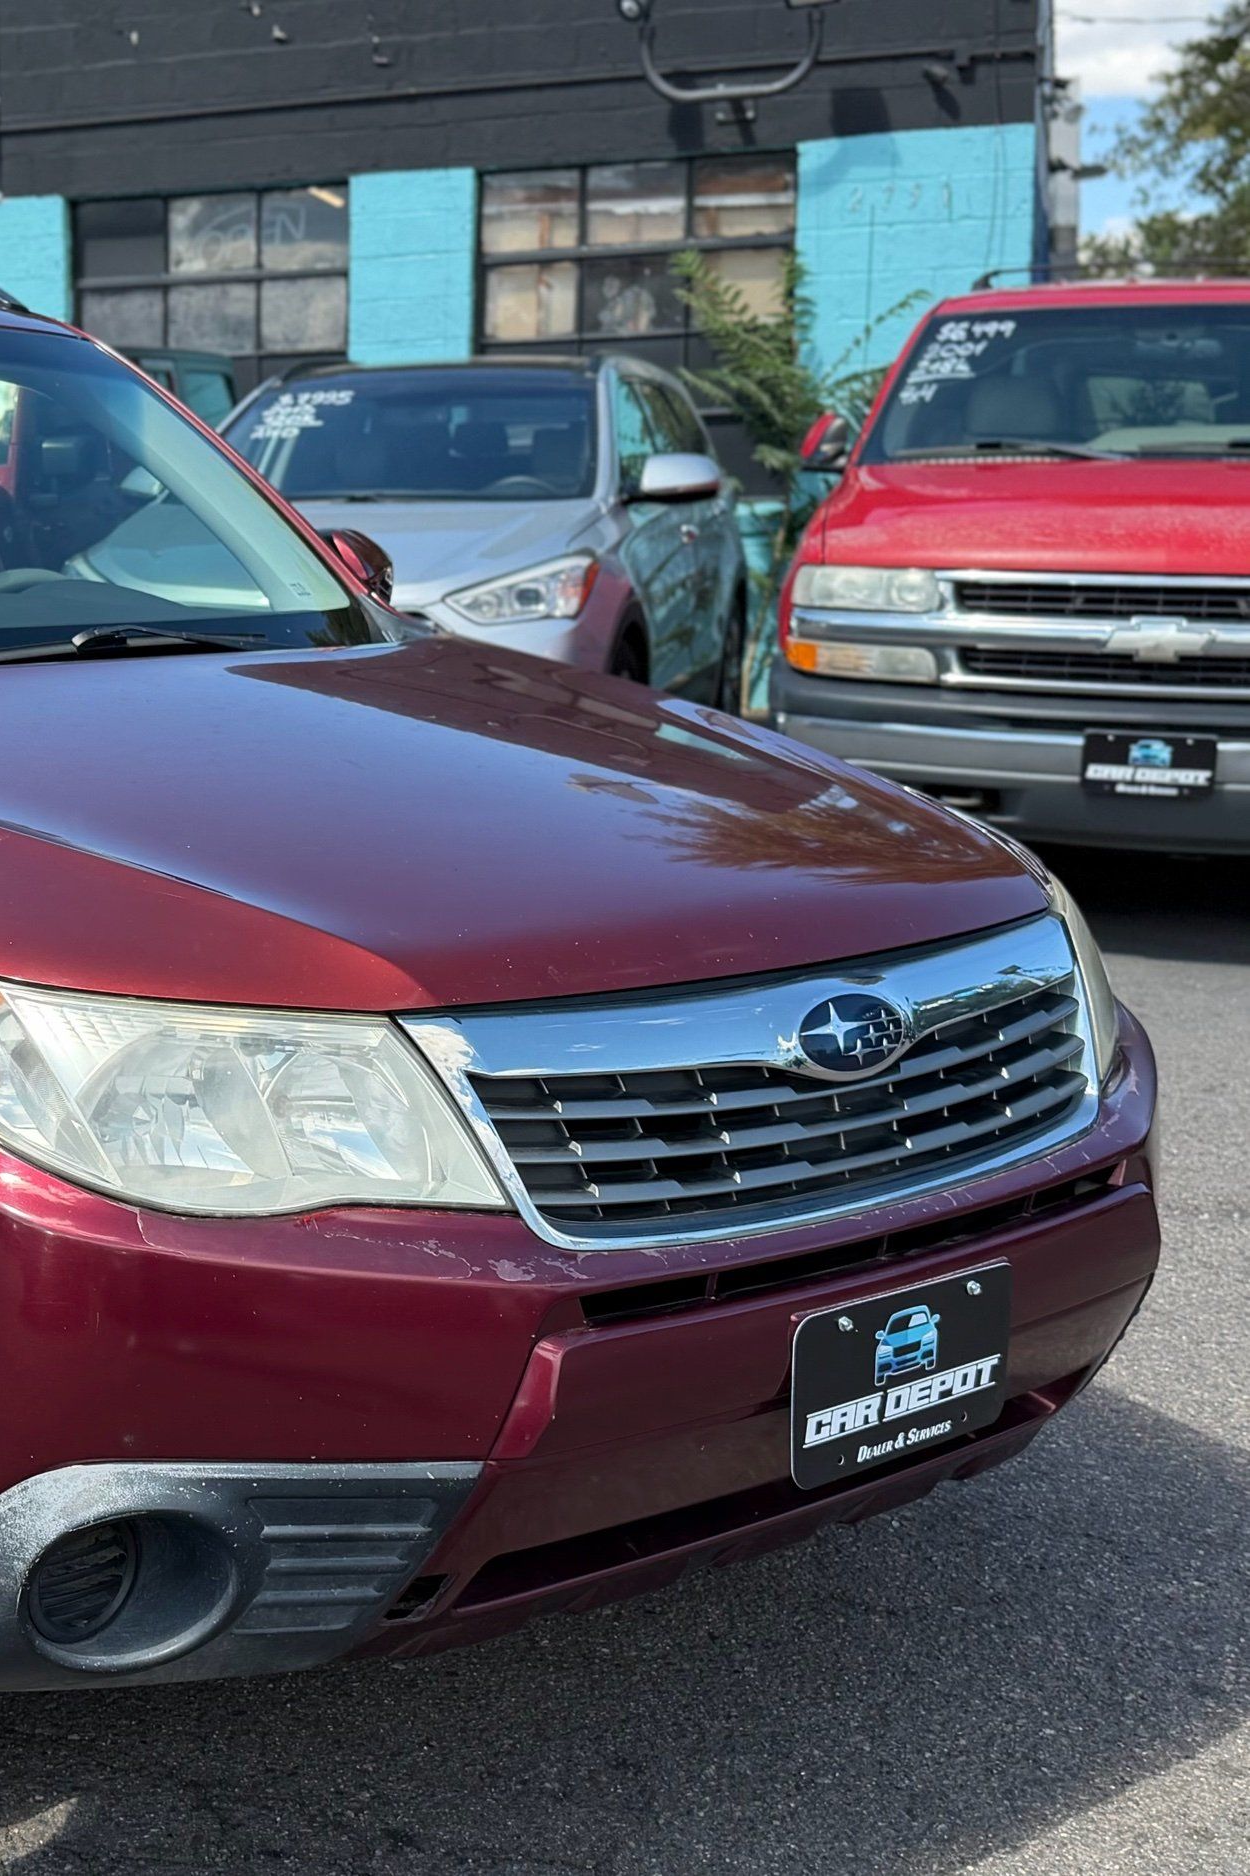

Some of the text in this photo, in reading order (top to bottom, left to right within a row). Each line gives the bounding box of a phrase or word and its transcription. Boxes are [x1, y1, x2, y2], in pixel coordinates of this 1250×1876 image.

[804, 1355, 1001, 1447] CAR DEPOT
[894, 1432, 905, 1451] &
